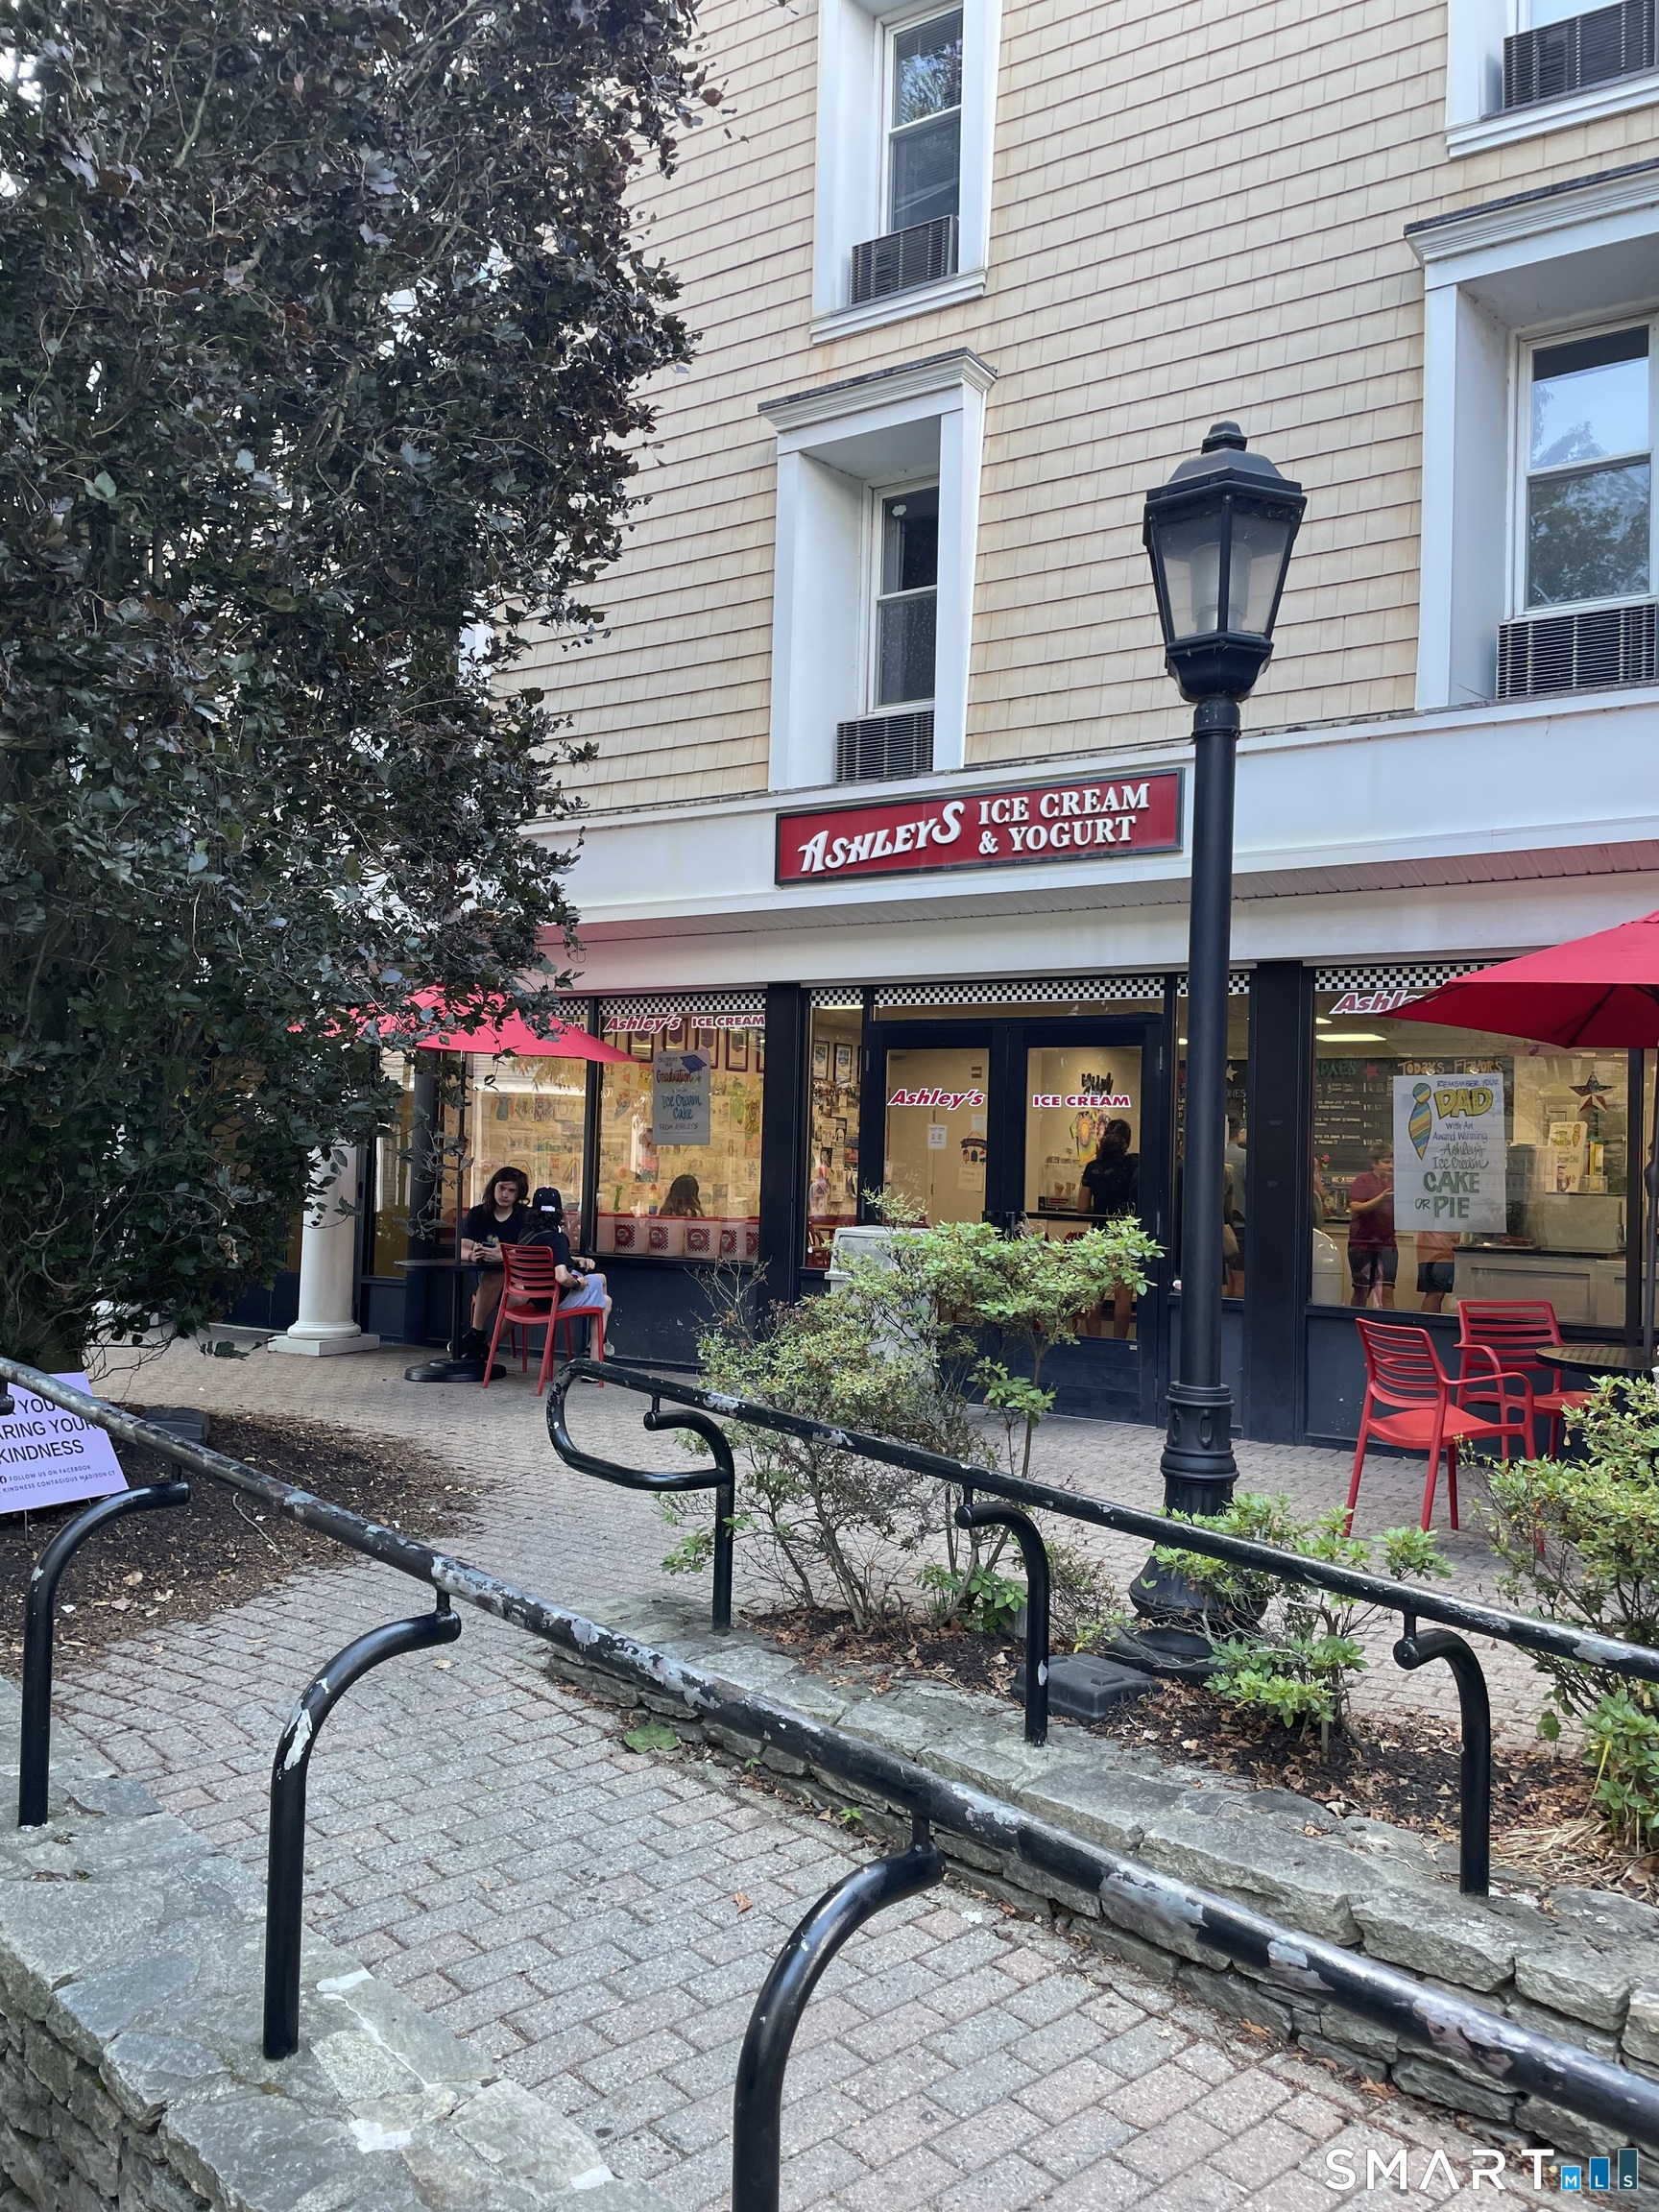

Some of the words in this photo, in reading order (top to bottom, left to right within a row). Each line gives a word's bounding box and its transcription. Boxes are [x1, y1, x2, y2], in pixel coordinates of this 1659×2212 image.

[797, 801, 966, 873] ASHLEYS
[978, 796, 1029, 825] ICE
[1040, 782, 1150, 819] CREAM
[978, 830, 998, 854] &
[1009, 816, 1137, 853] YOGURT
[603, 1014, 682, 1034] Ashley's
[691, 1016, 713, 1029] ICE
[715, 1014, 765, 1028] CREAM
[676, 1094, 702, 1106] Cream
[887, 1088, 986, 1110] Ashley's
[1032, 1094, 1061, 1108] ICE
[1065, 1094, 1131, 1108] CREAM
[1433, 1087, 1493, 1119] DAD
[673, 1107, 693, 1120] Cake
[1463, 1121, 1474, 1130] An
[1432, 1132, 1455, 1141] Award
[1457, 1132, 1487, 1143] Winning
[1431, 1156, 1451, 1169] Ice
[1452, 1157, 1489, 1169] Cream
[1424, 1171, 1479, 1193] CAKE
[1414, 1197, 1431, 1210] OR
[1433, 1196, 1470, 1218] PIE
[0, 1421, 46, 1440] RING
[0, 1439, 84, 1465] KINDNESS
[3, 1482, 36, 1493] KINDNESS
[36, 1477, 78, 1488] CONTAGIOUS
[79, 1472, 107, 1481] MADISON
[9, 1471, 36, 1481] FOLLOW
[59, 1464, 92, 1474] FACEBOOK
